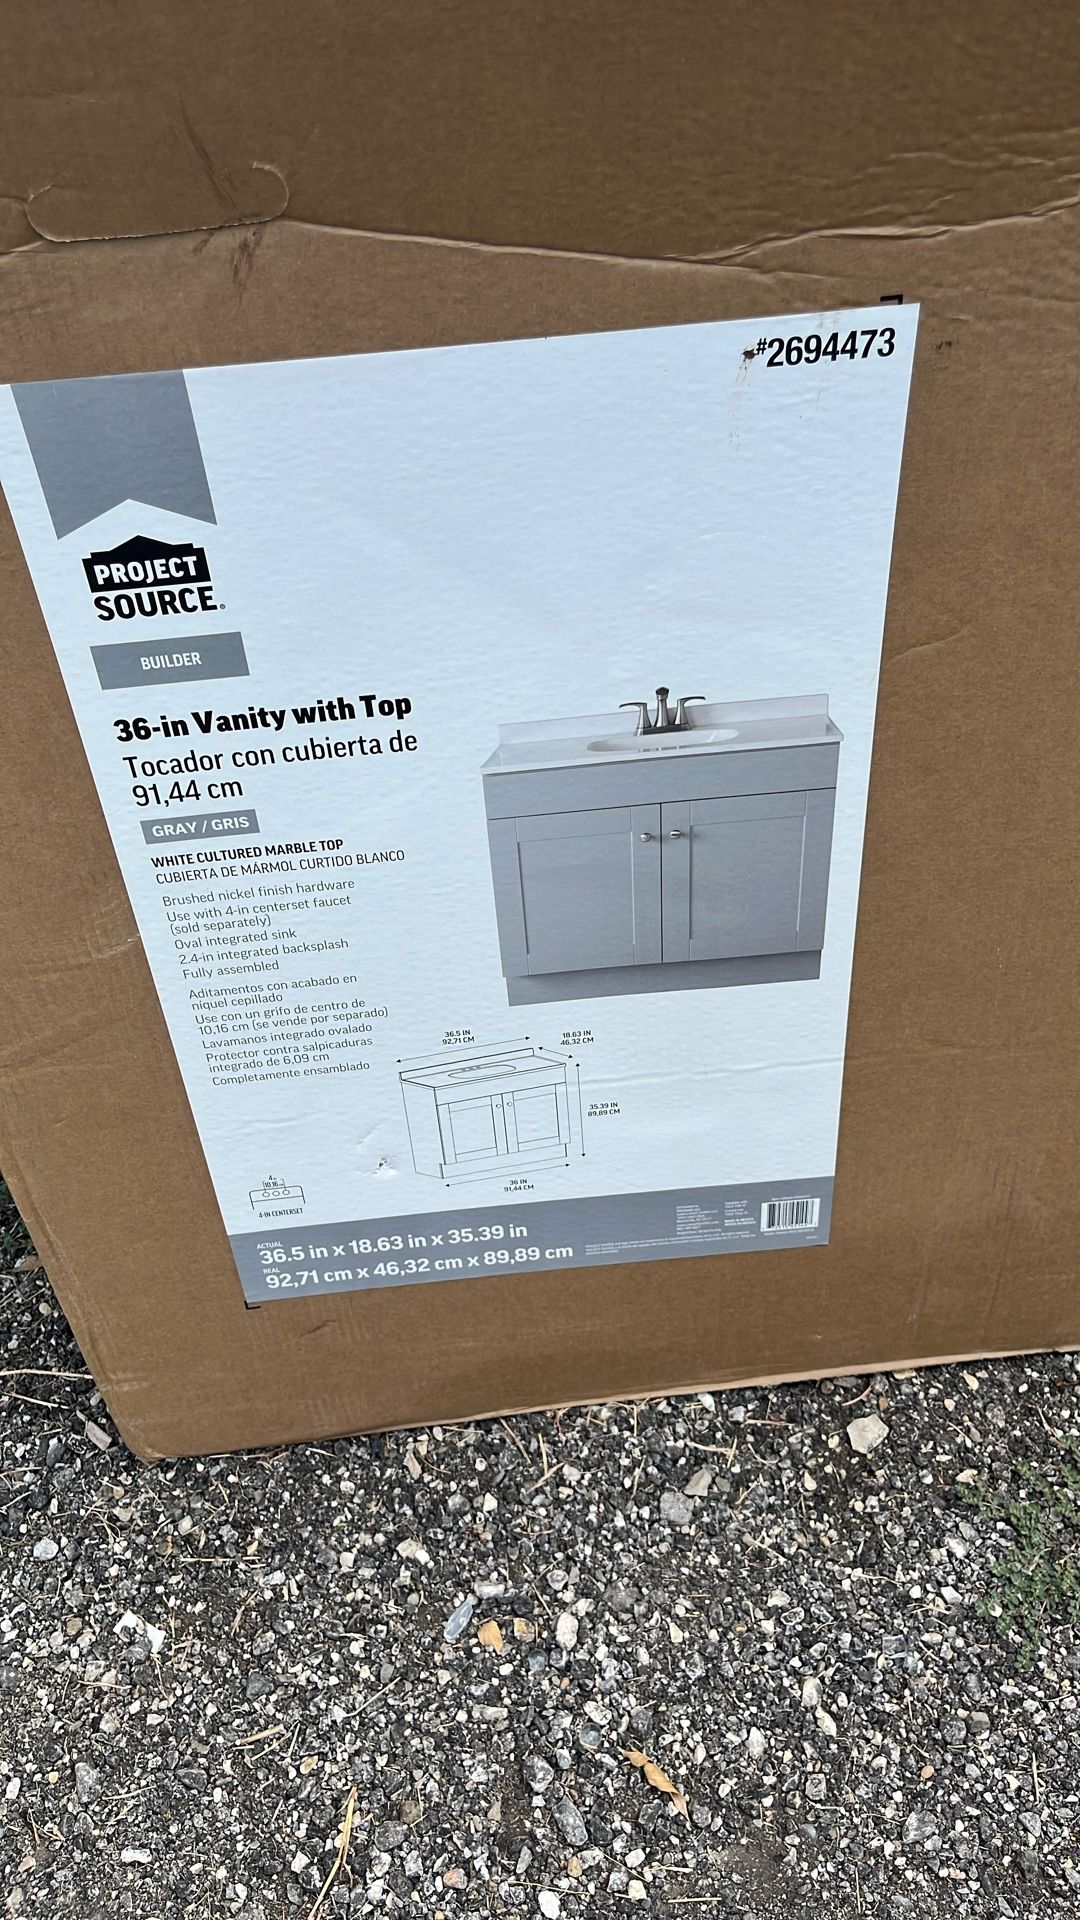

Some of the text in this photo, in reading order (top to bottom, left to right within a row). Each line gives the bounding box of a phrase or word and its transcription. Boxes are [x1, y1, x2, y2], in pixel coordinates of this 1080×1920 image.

[756, 328, 895, 367] #2694473
[93, 556, 198, 585] PROJECT
[94, 586, 218, 621] SOURCE
[140, 652, 202, 670] BUILDER
[113, 695, 412, 742] 36-in Vanity with Top
[123, 730, 417, 778] Tocador con cubierta de
[132, 779, 242, 808] 91,44 cm
[152, 816, 249, 837] GRAY / GRIS
[151, 839, 343, 868] WHITE CULTURED MARBLE TOP
[156, 850, 404, 884] CUBIERTA DE MÁRMOL CURTIDO BLANCO
[163, 880, 355, 906] Brushed nickel finish hardware
[167, 897, 353, 922] Use with 4-in centerset faucet
[170, 914, 271, 936] (sold separately)
[175, 928, 297, 949] Oval integrated sink
[179, 939, 349, 964] 2.4-in integrated backsplash
[183, 960, 279, 979] Fully assembled
[189, 975, 357, 999] Aditamentos con acabado en
[231, 993, 282, 1006] cepillado
[195, 999, 365, 1024] Use con un grifo de centro de
[199, 1006, 388, 1036] 10,16 cm (se vende por separado)
[202, 1023, 372, 1049] Lavamanos integrado ovalado
[206, 1037, 372, 1063] Protector contra salpicaduras
[209, 1052, 329, 1073] integrado de 6,09 cm
[213, 1062, 370, 1086] Completamente ensamblado
[272, 1208, 303, 1216] CENTERSET
[257, 1241, 283, 1249] ACTUAL
[260, 1224, 527, 1264] 36.5 in x 18.63 in x 35.39 in
[266, 1246, 573, 1288] 92,71 cm x 46,32 cm x 89,89 cm
